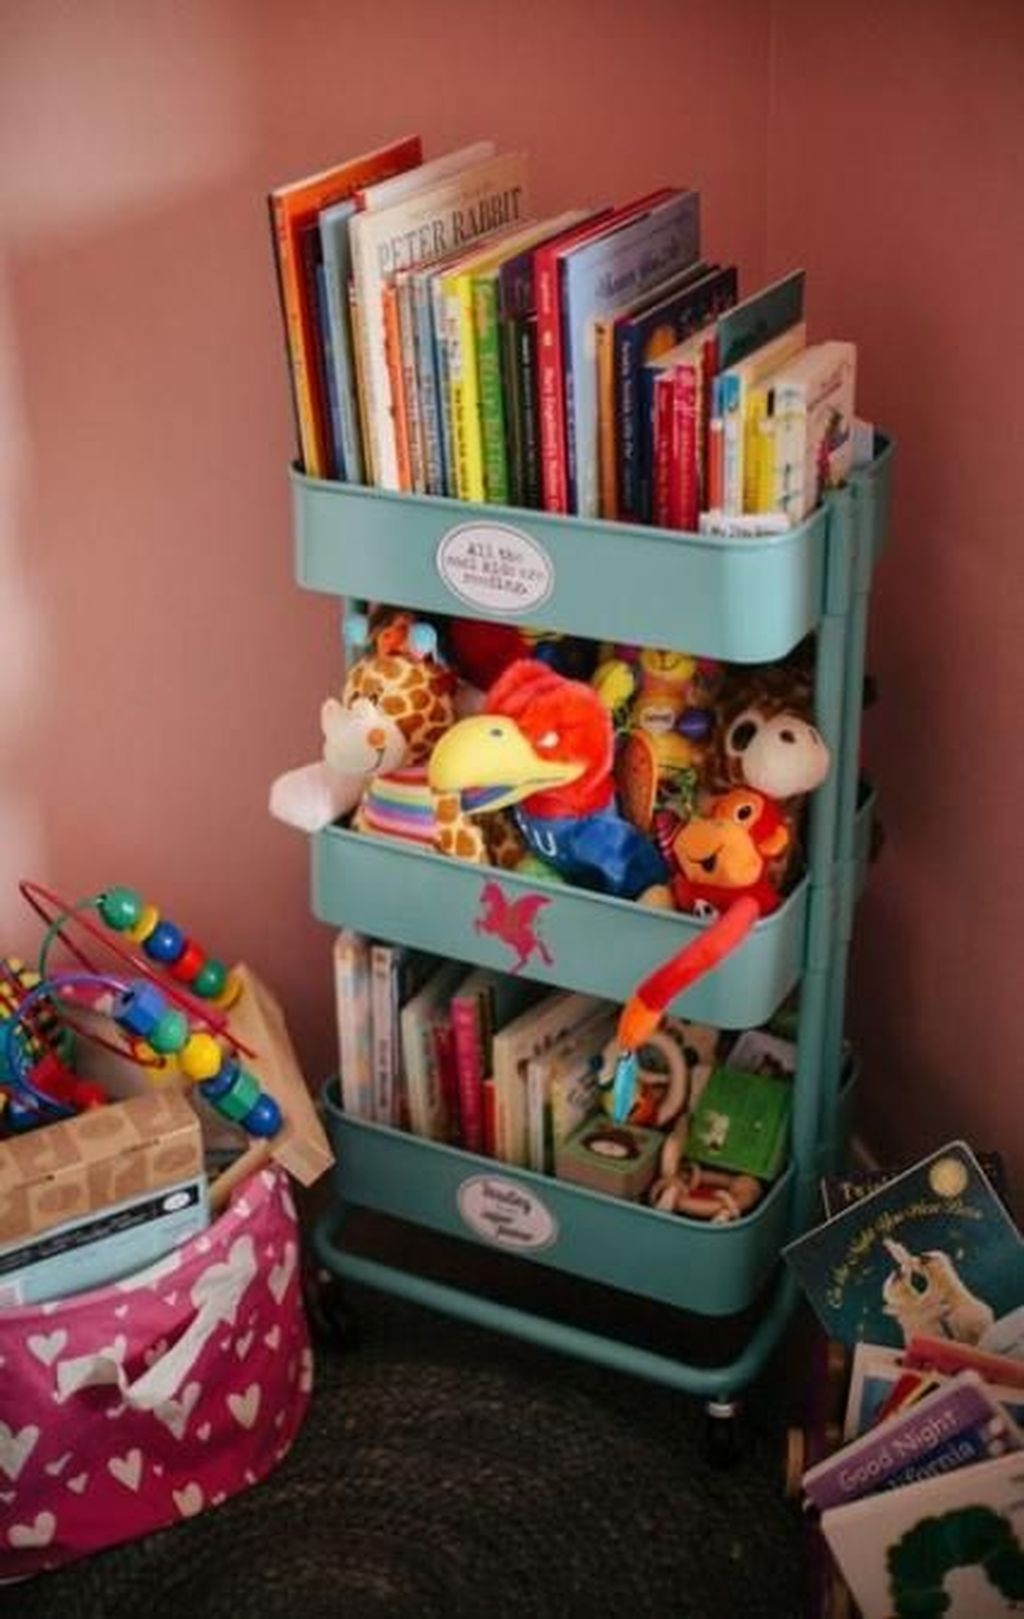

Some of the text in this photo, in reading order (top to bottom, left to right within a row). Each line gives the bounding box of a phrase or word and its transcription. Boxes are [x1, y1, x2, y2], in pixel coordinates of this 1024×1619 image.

[377, 186, 522, 267] PETER RABBIT
[838, 1410, 959, 1492] Good Night
